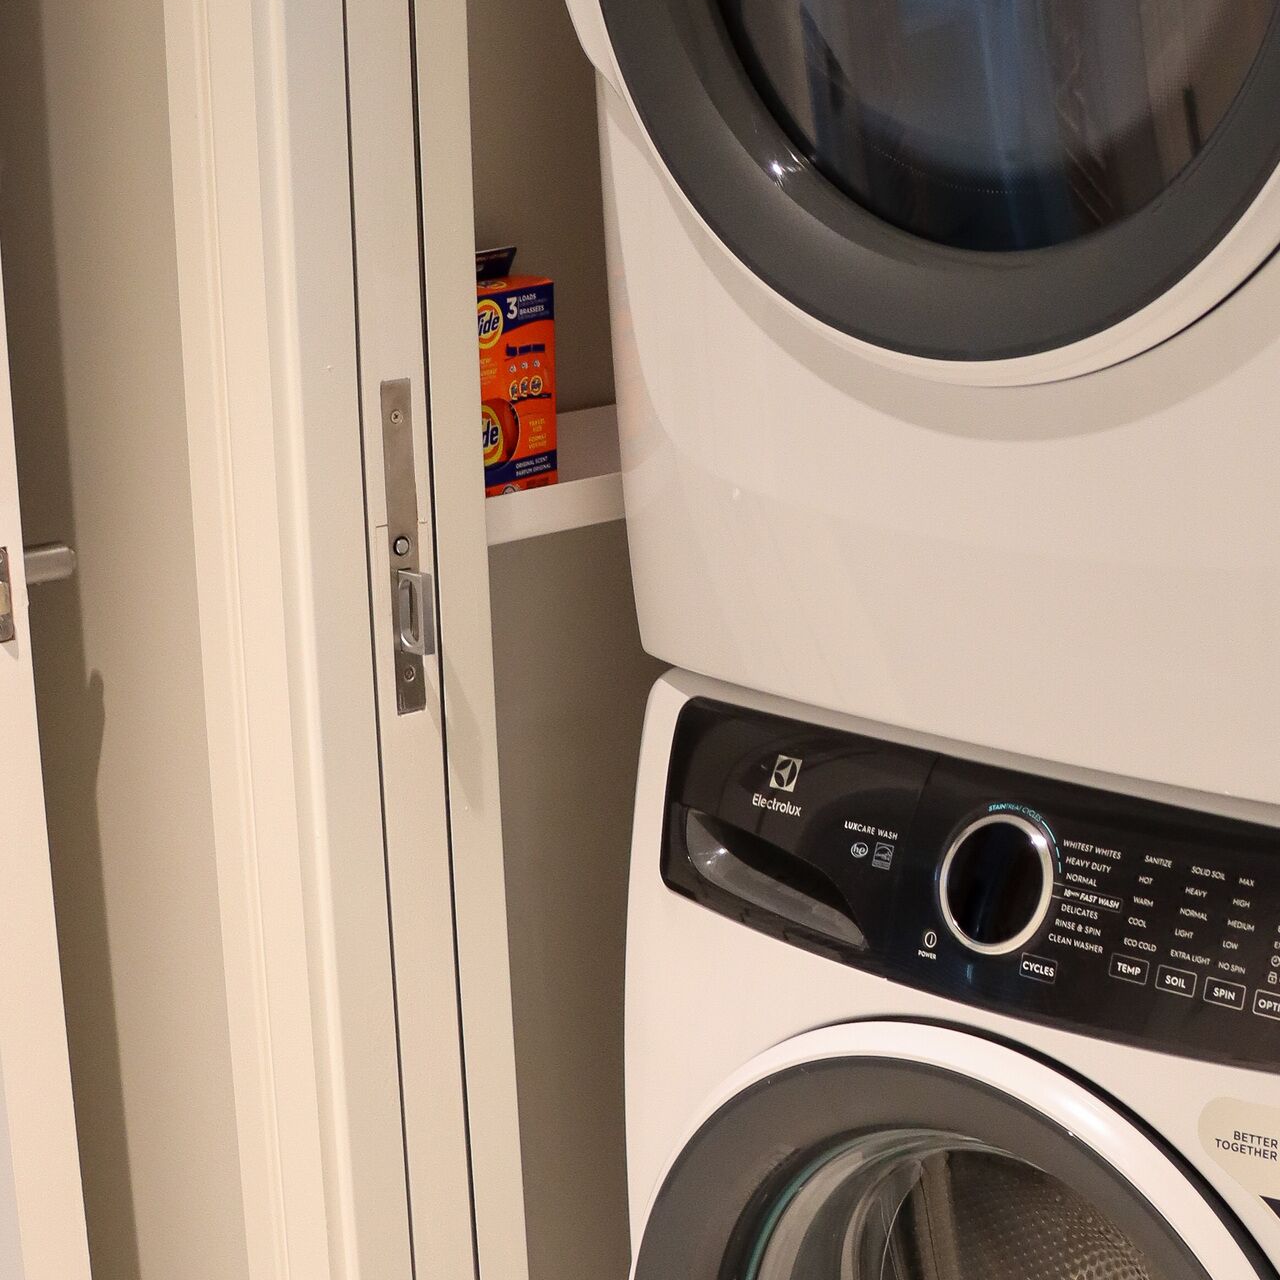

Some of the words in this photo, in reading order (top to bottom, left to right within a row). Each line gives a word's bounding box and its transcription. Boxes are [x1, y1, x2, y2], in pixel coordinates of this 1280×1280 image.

[506, 296, 518, 320] 3
[752, 792, 802, 817] Electrolux
[844, 820, 876, 836] LUXCARE
[877, 828, 898, 841] WASH
[1063, 839, 1094, 853] WHITEST
[1095, 846, 1122, 860] WHITES
[1065, 856, 1090, 868] HEAVY
[1091, 861, 1112, 874] DUTY
[1144, 855, 1173, 869] SANITIZE
[1065, 872, 1097, 887] NORMAL
[1138, 876, 1154, 885] HOT
[1211, 870, 1226, 881] SOIL
[1238, 877, 1255, 887] MAX
[1185, 887, 1208, 898] HEAVY
[1079, 892, 1098, 903] FAST
[1098, 897, 1120, 909] WASH
[1133, 896, 1154, 908] WARM
[1232, 898, 1251, 909] HIGH
[1061, 903, 1099, 920] DELICATES
[1180, 907, 1208, 921] NORMAL
[1054, 918, 1076, 931] RINSE
[1084, 926, 1101, 937] SPIN
[1128, 917, 1147, 928] COOL
[1227, 919, 1255, 933] MEDIUM
[1174, 928, 1194, 939] LIGHT
[1048, 933, 1072, 946] CLEAN
[1073, 939, 1104, 954] WASHER
[1123, 937, 1138, 948] ECO
[1138, 941, 1157, 953] COLD
[1222, 940, 1239, 950] LOW
[917, 949, 937, 960] POWER
[1170, 949, 1191, 961] EXTRA
[1191, 955, 1211, 966] LIGHT
[1022, 960, 1055, 978] CYCLES
[1117, 962, 1142, 976] TEMP
[1218, 961, 1230, 971] NO
[1230, 963, 1246, 975] SPIN
[1165, 974, 1186, 989] SOIL
[1212, 987, 1236, 1001] SPIN
[1233, 1130, 1278, 1150] BETTER
[1215, 1137, 1278, 1162] TOGETHER
